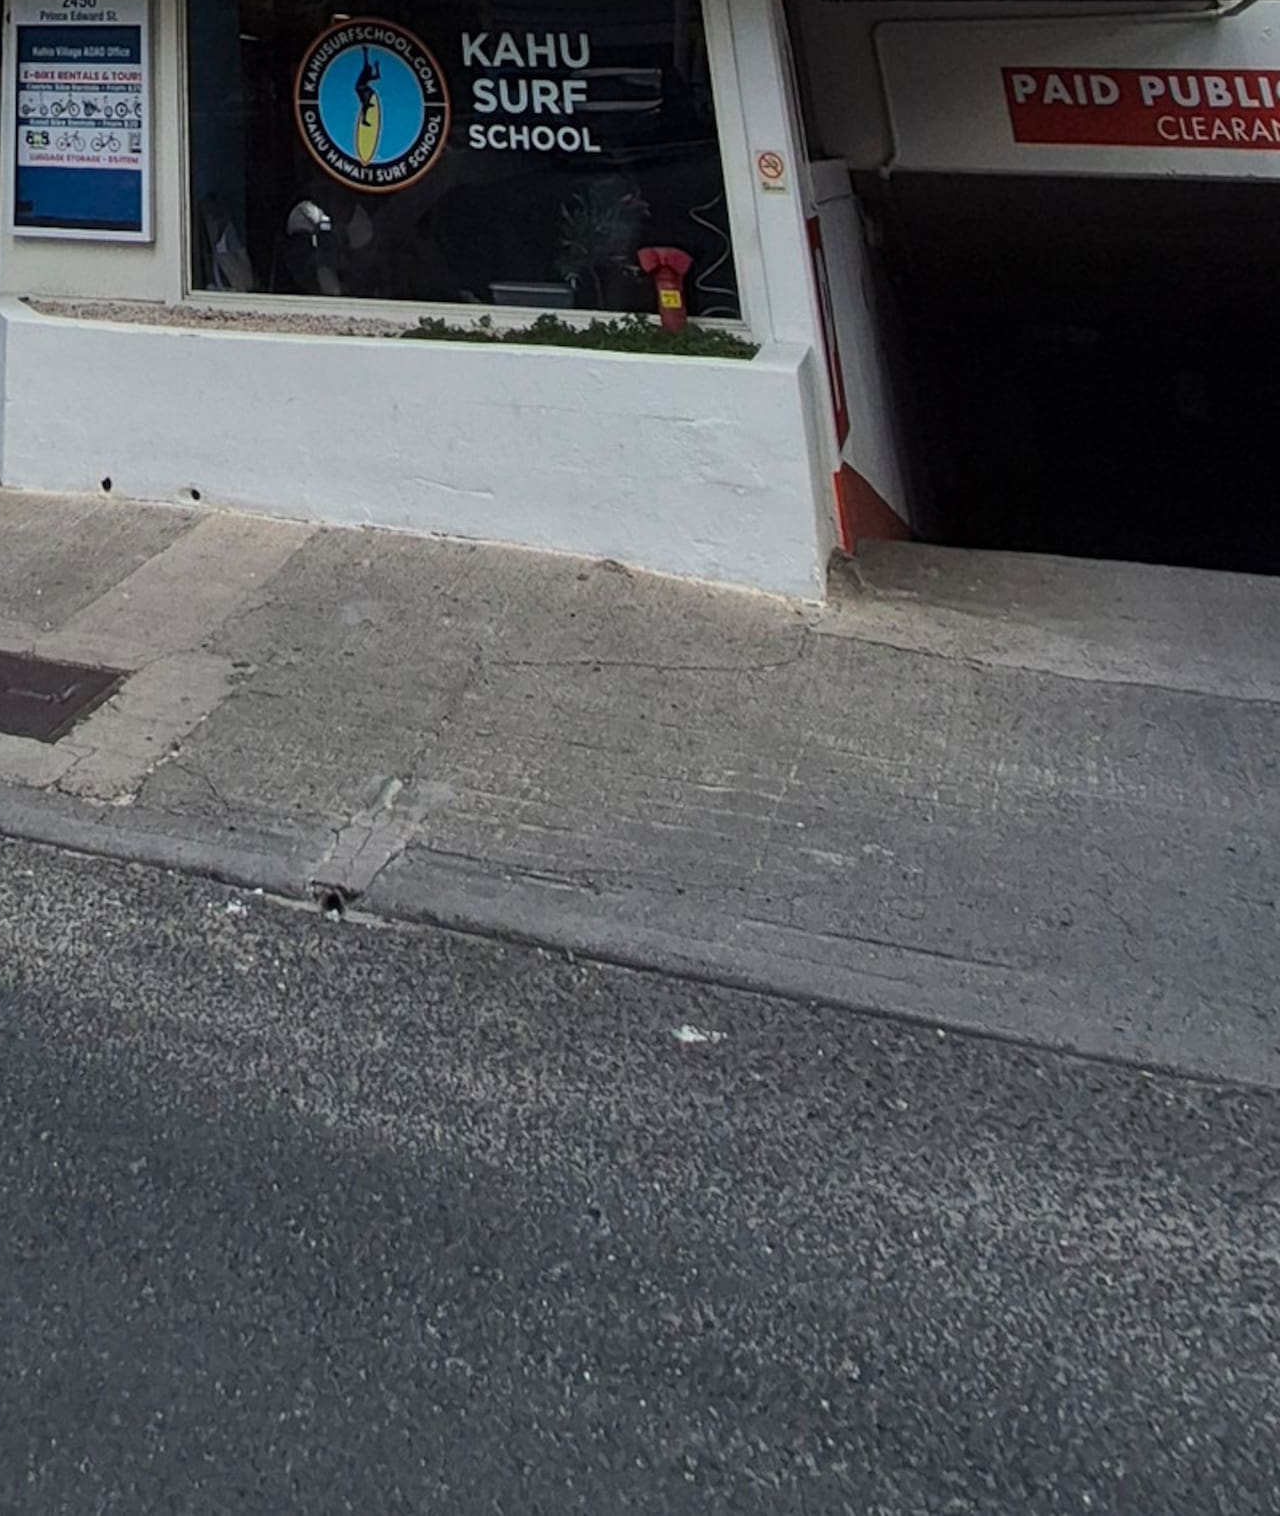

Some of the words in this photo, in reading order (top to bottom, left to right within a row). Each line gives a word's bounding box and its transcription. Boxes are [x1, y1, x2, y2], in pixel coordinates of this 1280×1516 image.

[70, 10, 104, 21] Edward
[303, 26, 438, 95] KAHUSURFSCHOOL.COM
[461, 31, 590, 69] KAHU
[58, 71, 99, 81] RENTALS
[1011, 73, 1120, 105] PAID
[1138, 75, 1280, 108] PUBLI
[472, 78, 588, 114] SURF
[303, 111, 329, 151] OAHU
[376, 164, 408, 182] SURF
[409, 114, 441, 169] SCHOOL
[468, 124, 602, 153] SCHOOL
